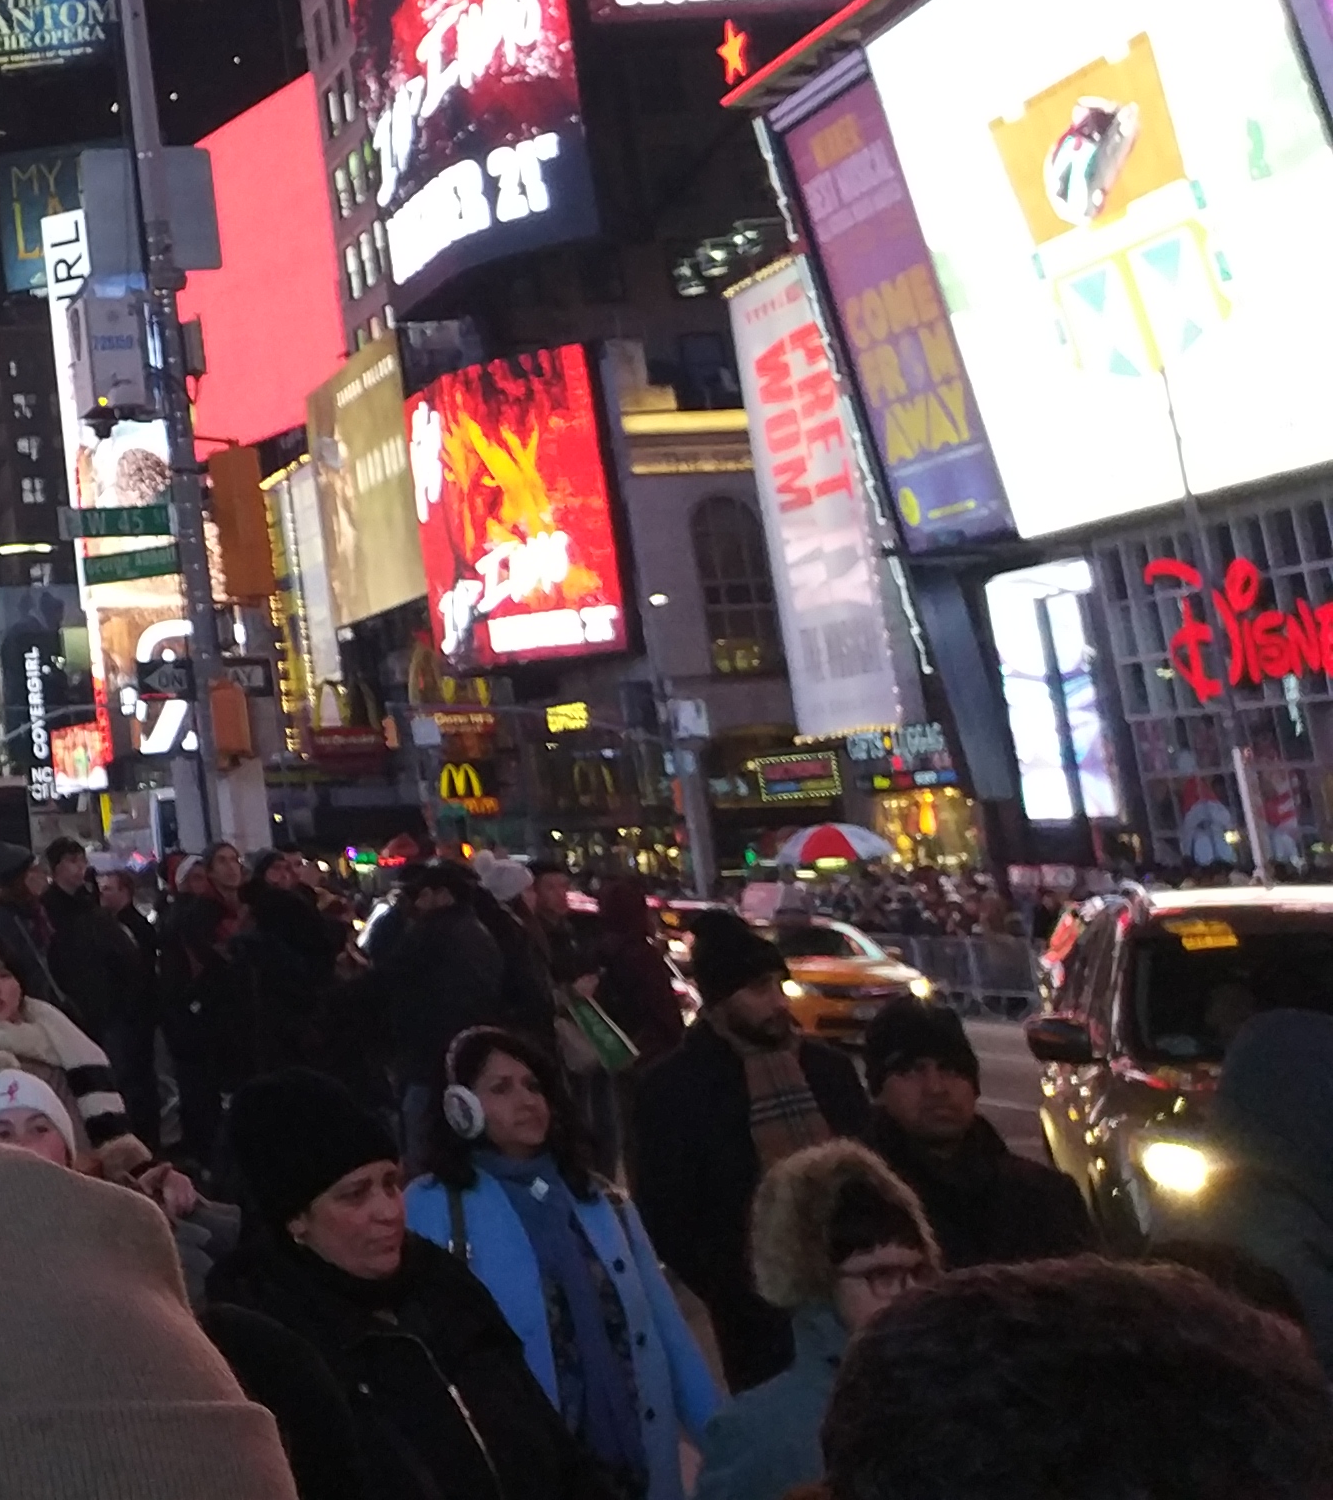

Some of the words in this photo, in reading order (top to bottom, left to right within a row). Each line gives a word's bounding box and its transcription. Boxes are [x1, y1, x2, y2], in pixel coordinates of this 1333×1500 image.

[34, 24, 105, 48] OPERA
[11, 160, 62, 200] MY
[845, 262, 940, 349] COME
[885, 379, 970, 465] AWAY
[85, 510, 106, 535] W
[117, 510, 144, 534] 45
[23, 646, 50, 760] COVERGIRL
